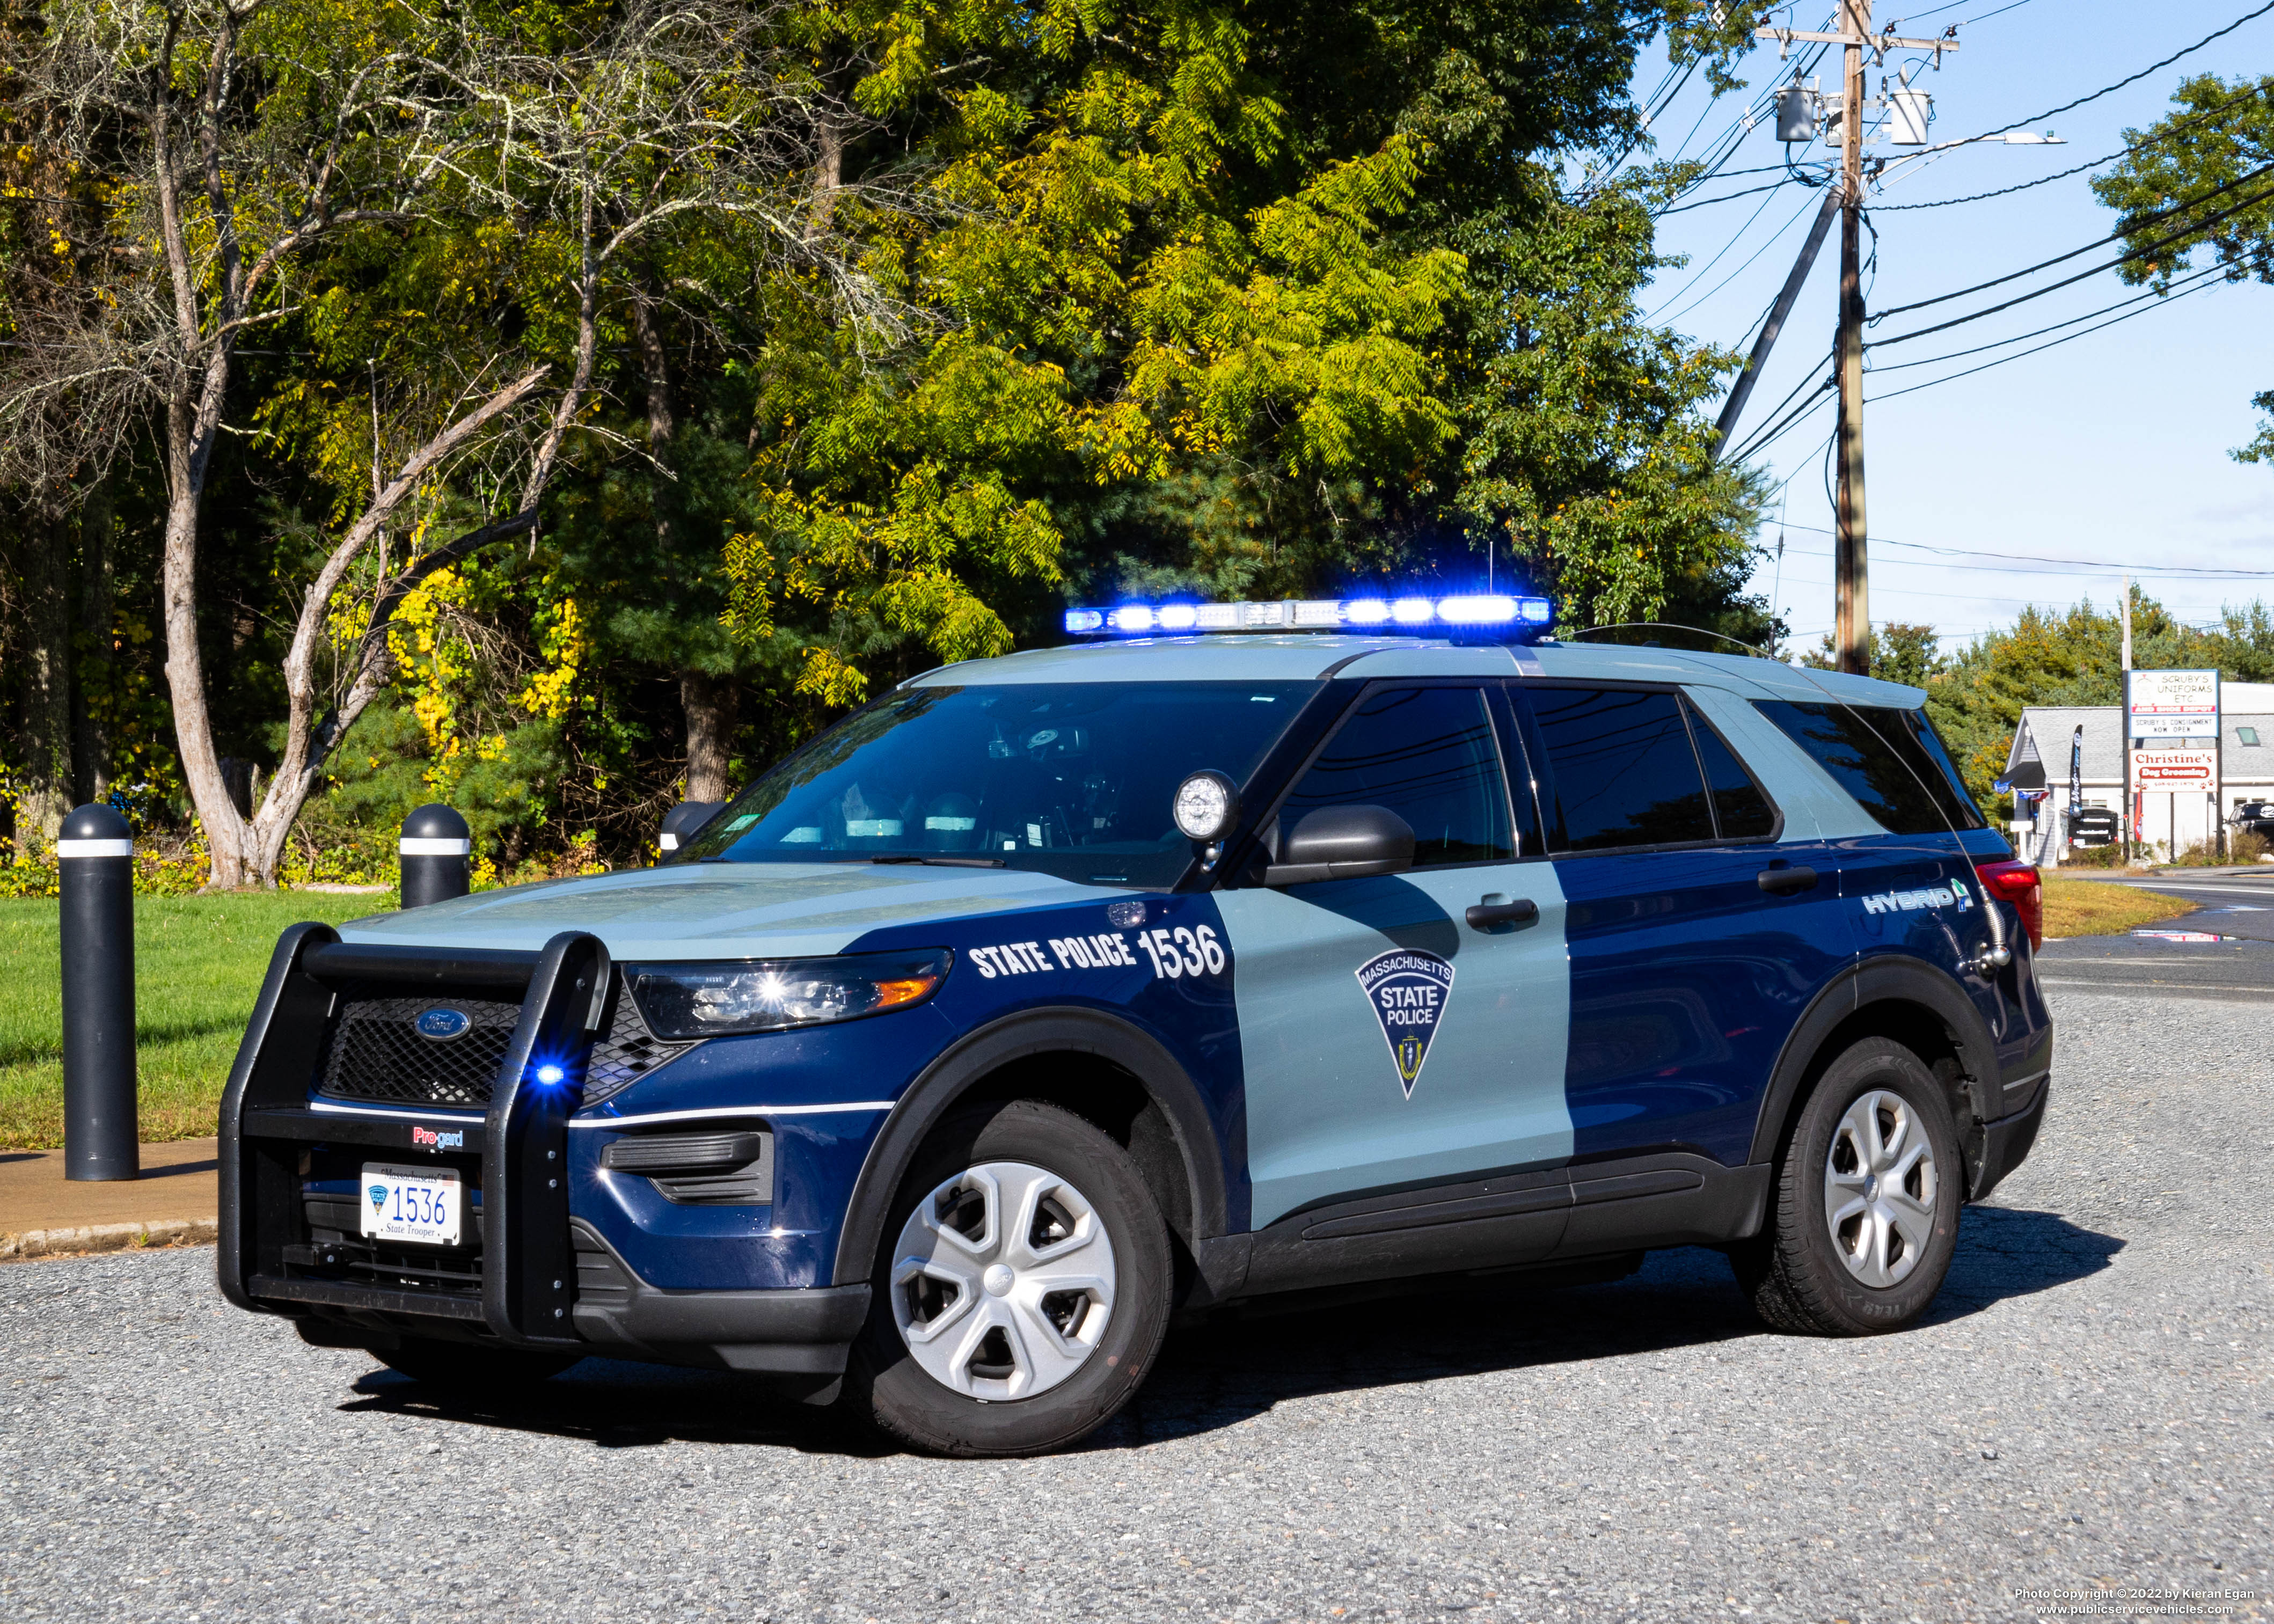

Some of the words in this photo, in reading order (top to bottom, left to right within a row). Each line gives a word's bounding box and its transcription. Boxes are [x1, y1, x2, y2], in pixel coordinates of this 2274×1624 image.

[2162, 675, 2209, 683] SCRUBY'S
[2158, 685, 2212, 693] UNIFORMS
[2136, 754, 2212, 763] Christine's
[2142, 768, 2160, 777] Dog
[2161, 768, 2206, 777] Grooming
[1862, 888, 1955, 914] HYBRID
[969, 941, 1054, 978] STATE
[1048, 933, 1137, 969] POLICE
[1137, 925, 1225, 978] 1536
[1361, 956, 1451, 986] MASSACHUSETTS
[1381, 986, 1438, 1008] STATE
[425, 1013, 455, 1030] Ford
[1387, 1009, 1433, 1025] POLICE
[384, 1168, 437, 1184] Massachusetts
[393, 1186, 445, 1225] 1536
[386, 1223, 405, 1233] State
[407, 1225, 435, 1238] Trooper
